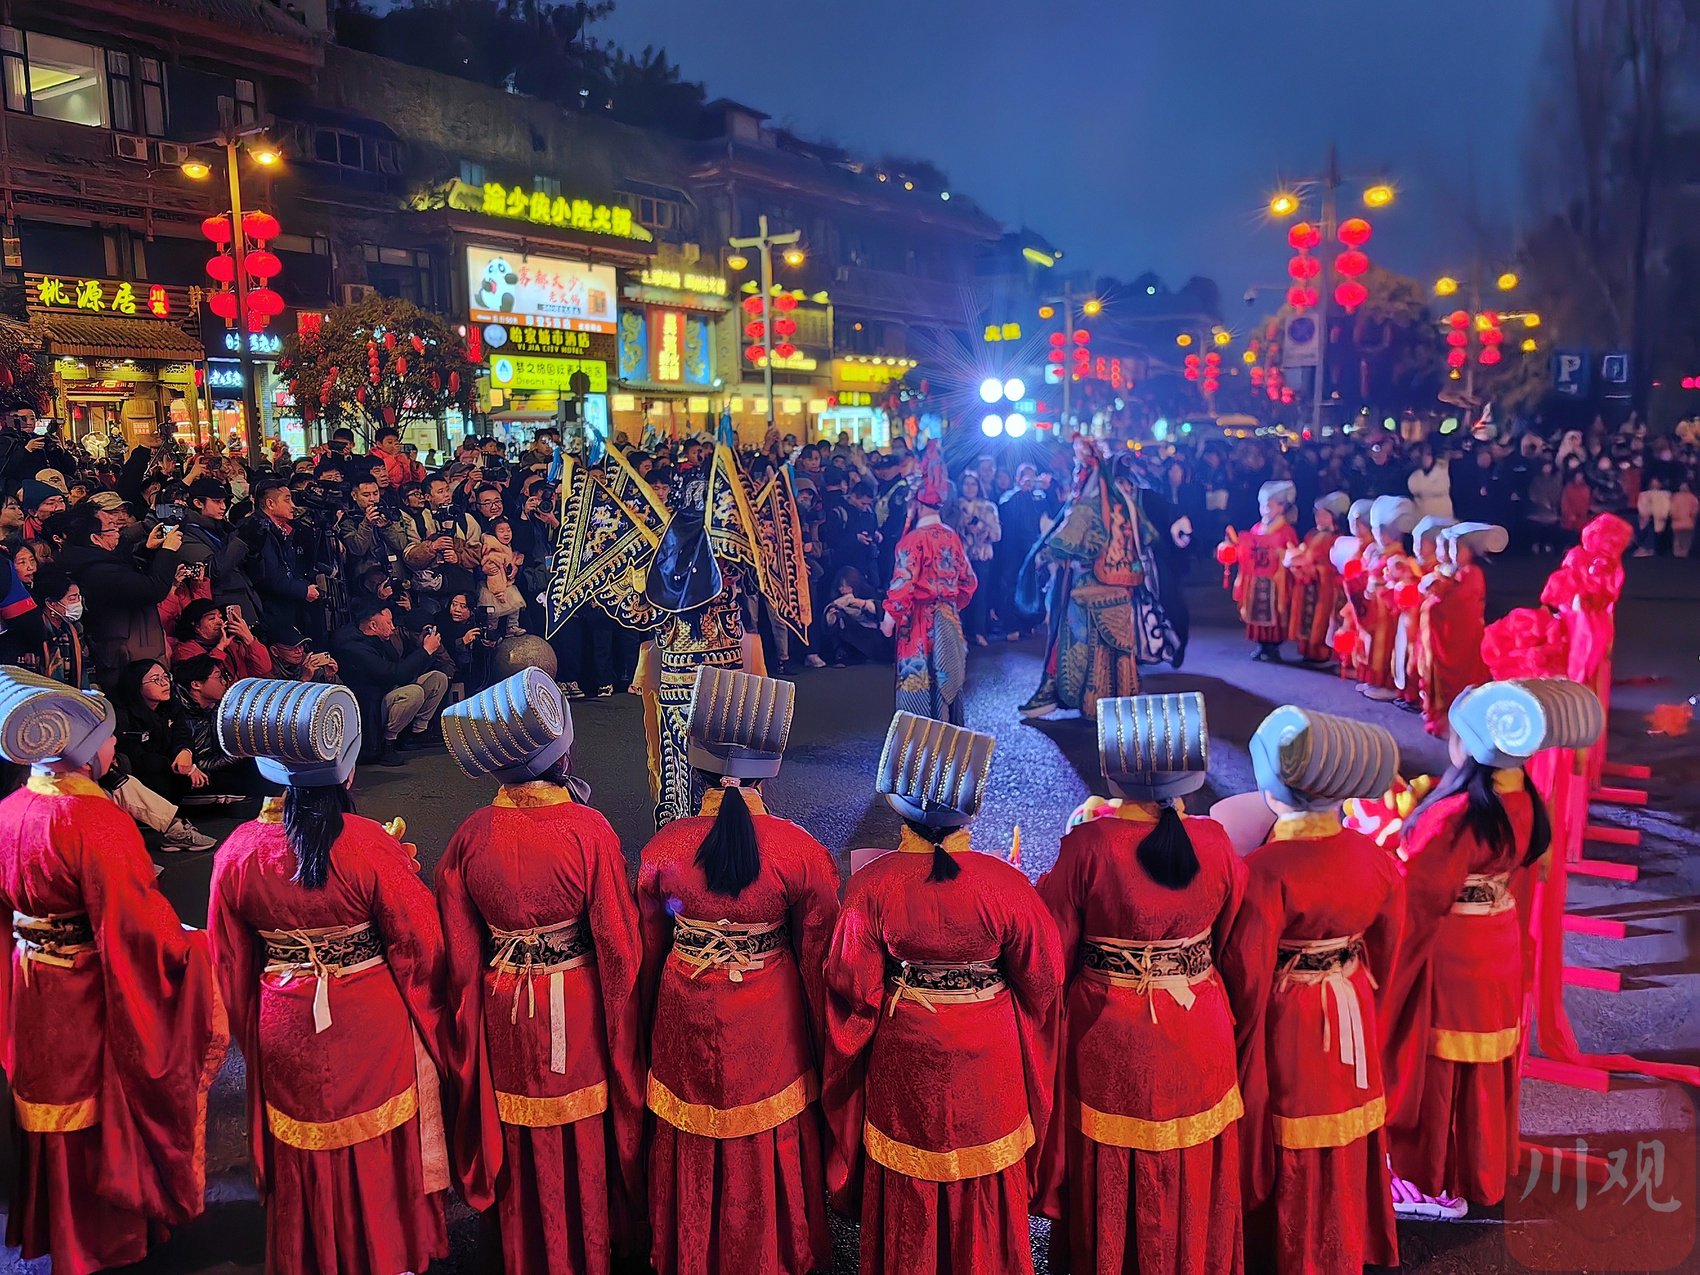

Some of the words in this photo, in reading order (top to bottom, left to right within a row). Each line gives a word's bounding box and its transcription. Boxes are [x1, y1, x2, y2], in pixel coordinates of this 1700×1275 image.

[37, 276, 136, 314] 桃源居
[1558, 355, 1581, 382] P
